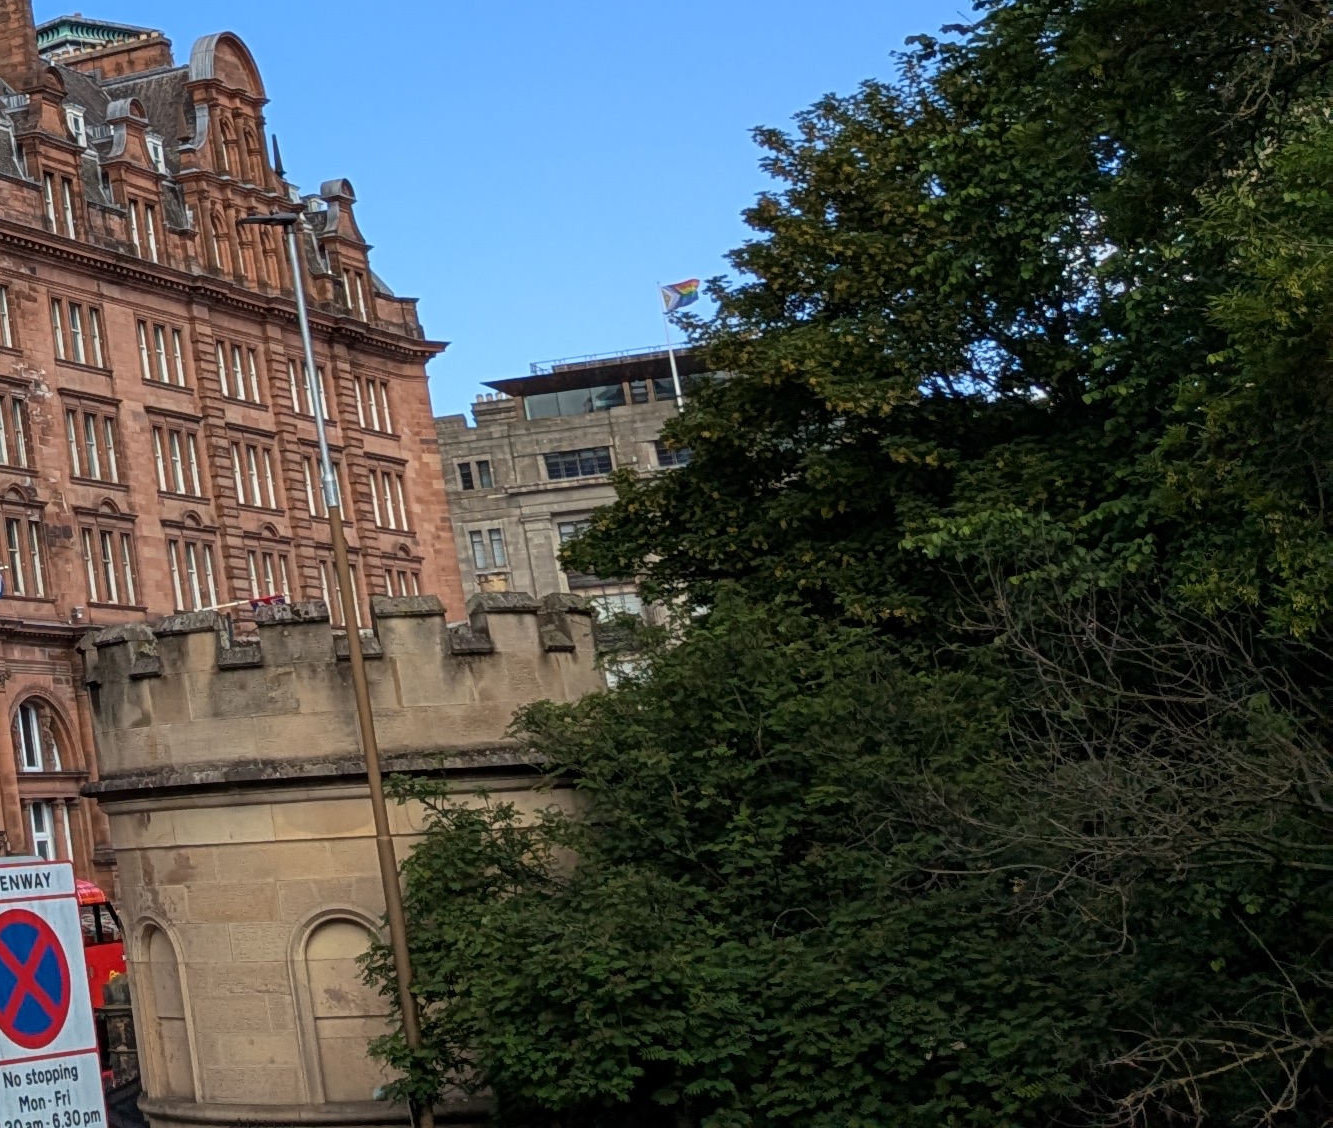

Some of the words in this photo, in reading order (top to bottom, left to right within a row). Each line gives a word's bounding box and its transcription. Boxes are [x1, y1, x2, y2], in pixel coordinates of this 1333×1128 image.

[3, 1071, 21, 1088] No
[25, 1064, 79, 1086] stopping
[19, 1095, 46, 1112] Mon
[55, 1089, 71, 1107] Fri
